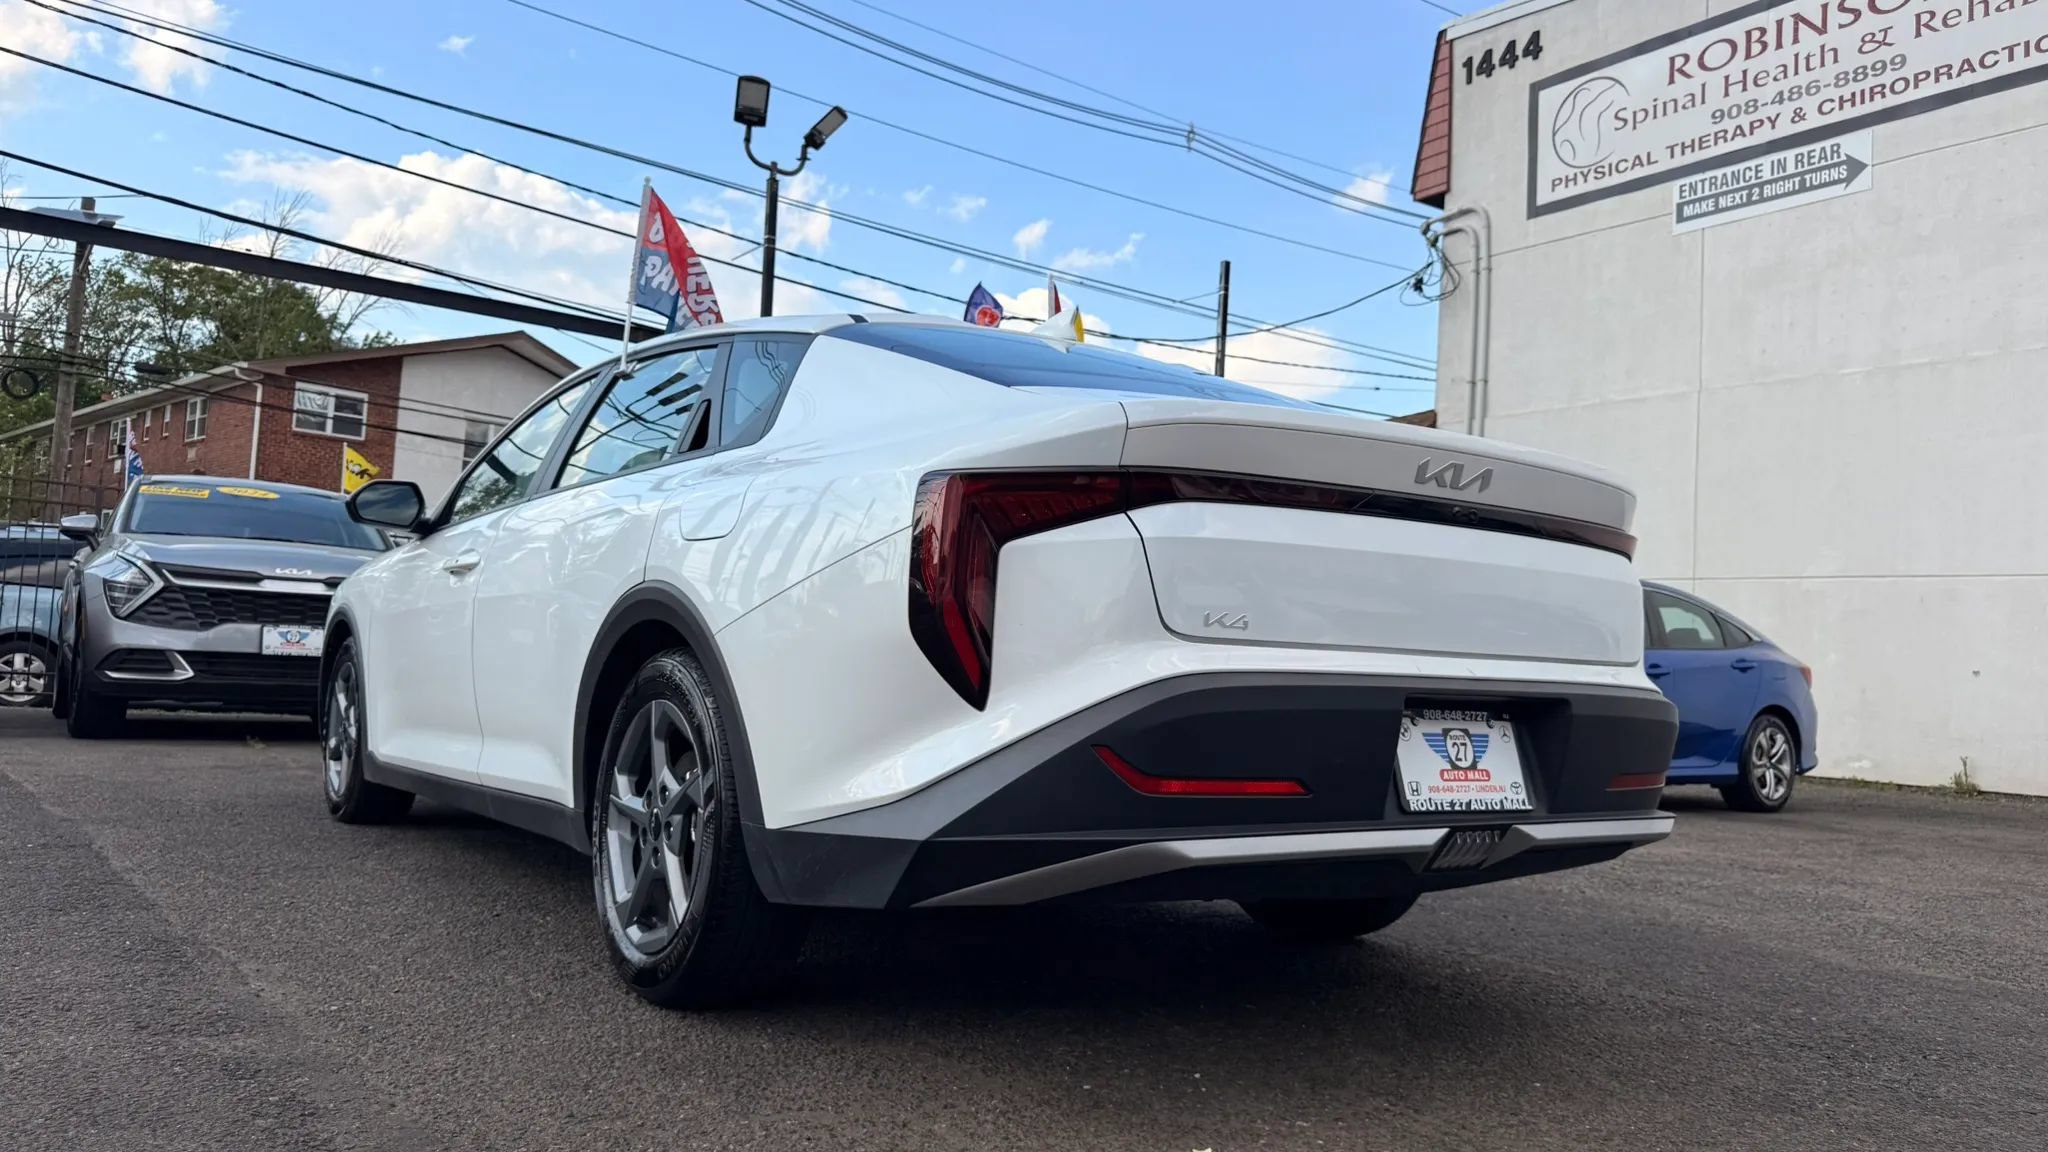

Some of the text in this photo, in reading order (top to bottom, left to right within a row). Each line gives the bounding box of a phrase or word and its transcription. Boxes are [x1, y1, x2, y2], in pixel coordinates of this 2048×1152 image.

[1462, 30, 1543, 85] 1444
[1613, 0, 2039, 132] Spinal Health & Reha
[1667, 0, 1928, 86] ROBINS
[1711, 53, 1907, 125] 908-486-8899
[1551, 151, 1659, 192] PHYSICAL
[1665, 112, 1782, 160] THERAPY
[1790, 106, 1808, 124] &
[1678, 142, 1842, 200] ENTRANCE IN REAR
[1683, 165, 1848, 218] MAKE NEXT 2 RIGHT TURNS
[1414, 457, 1494, 494] KIA
[1203, 610, 1249, 631] K4
[1423, 709, 1488, 721] 908-648-2727
[1443, 771, 1489, 780] AUTO MALL
[1452, 742, 1468, 762] 27
[1410, 798, 1533, 812] ROUTE 27 AUTO MALL
